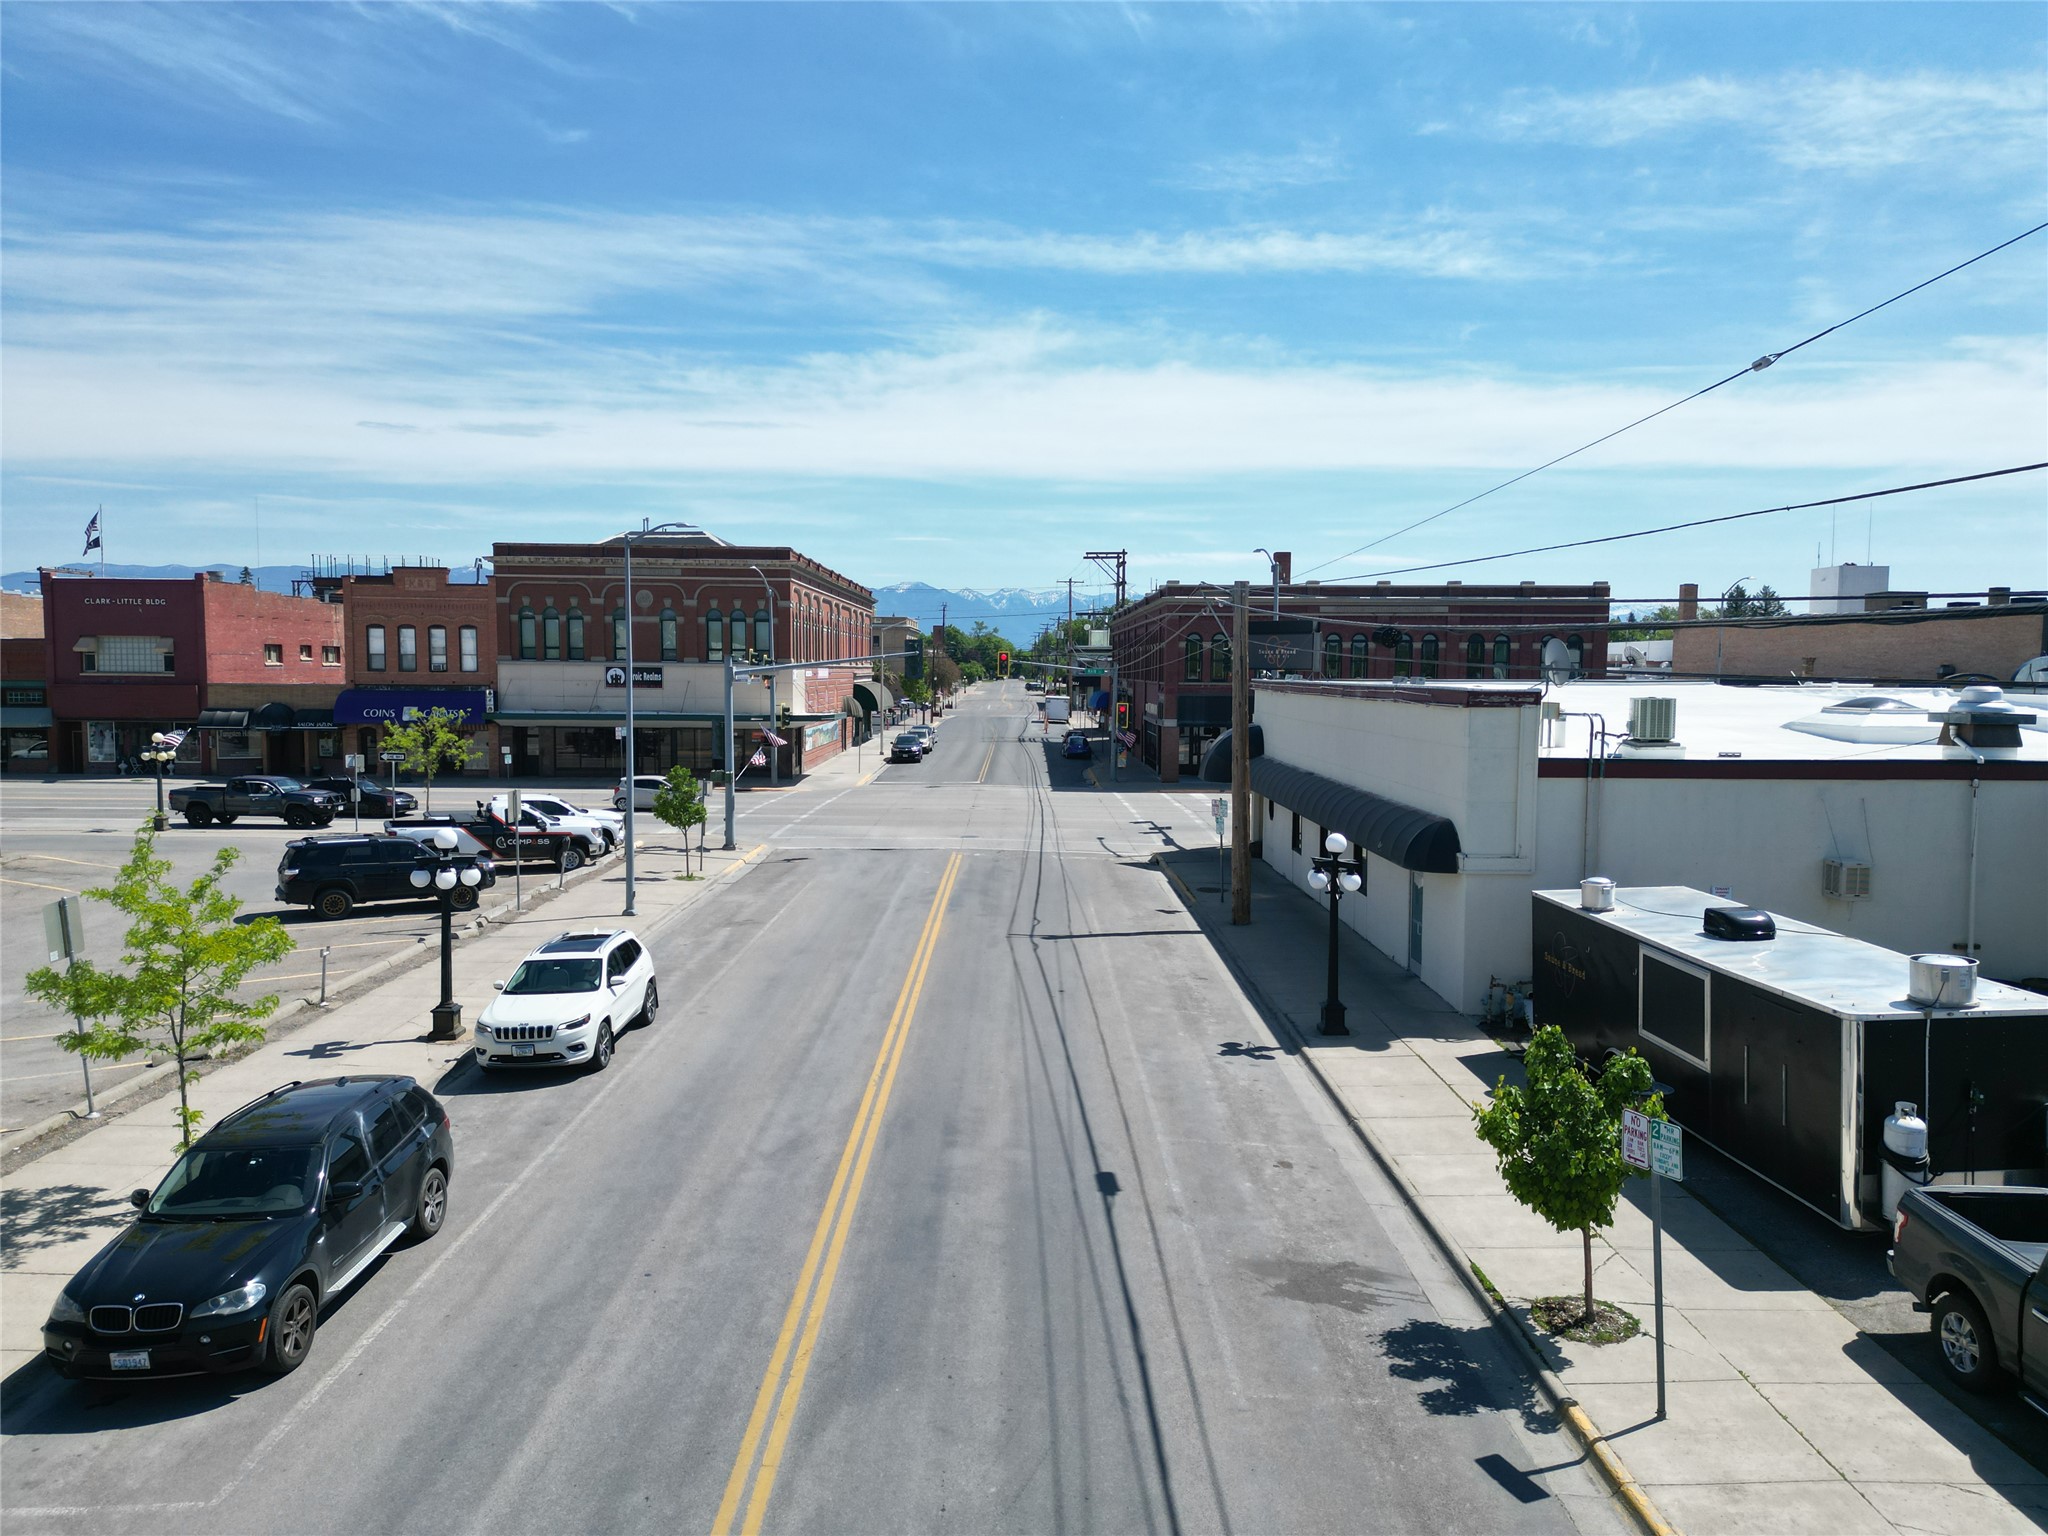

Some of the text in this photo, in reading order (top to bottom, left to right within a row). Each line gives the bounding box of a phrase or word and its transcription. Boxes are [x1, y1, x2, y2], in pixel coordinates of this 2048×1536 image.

[145, 598, 167, 606] BLDG
[643, 672, 662, 681] Realms
[363, 709, 396, 718] COINS
[1631, 1116, 1641, 1127] NO
[1624, 1125, 1648, 1141] PARKING
[1653, 1123, 1675, 1137] 2 HR
[1660, 1133, 1680, 1145] PARKING
